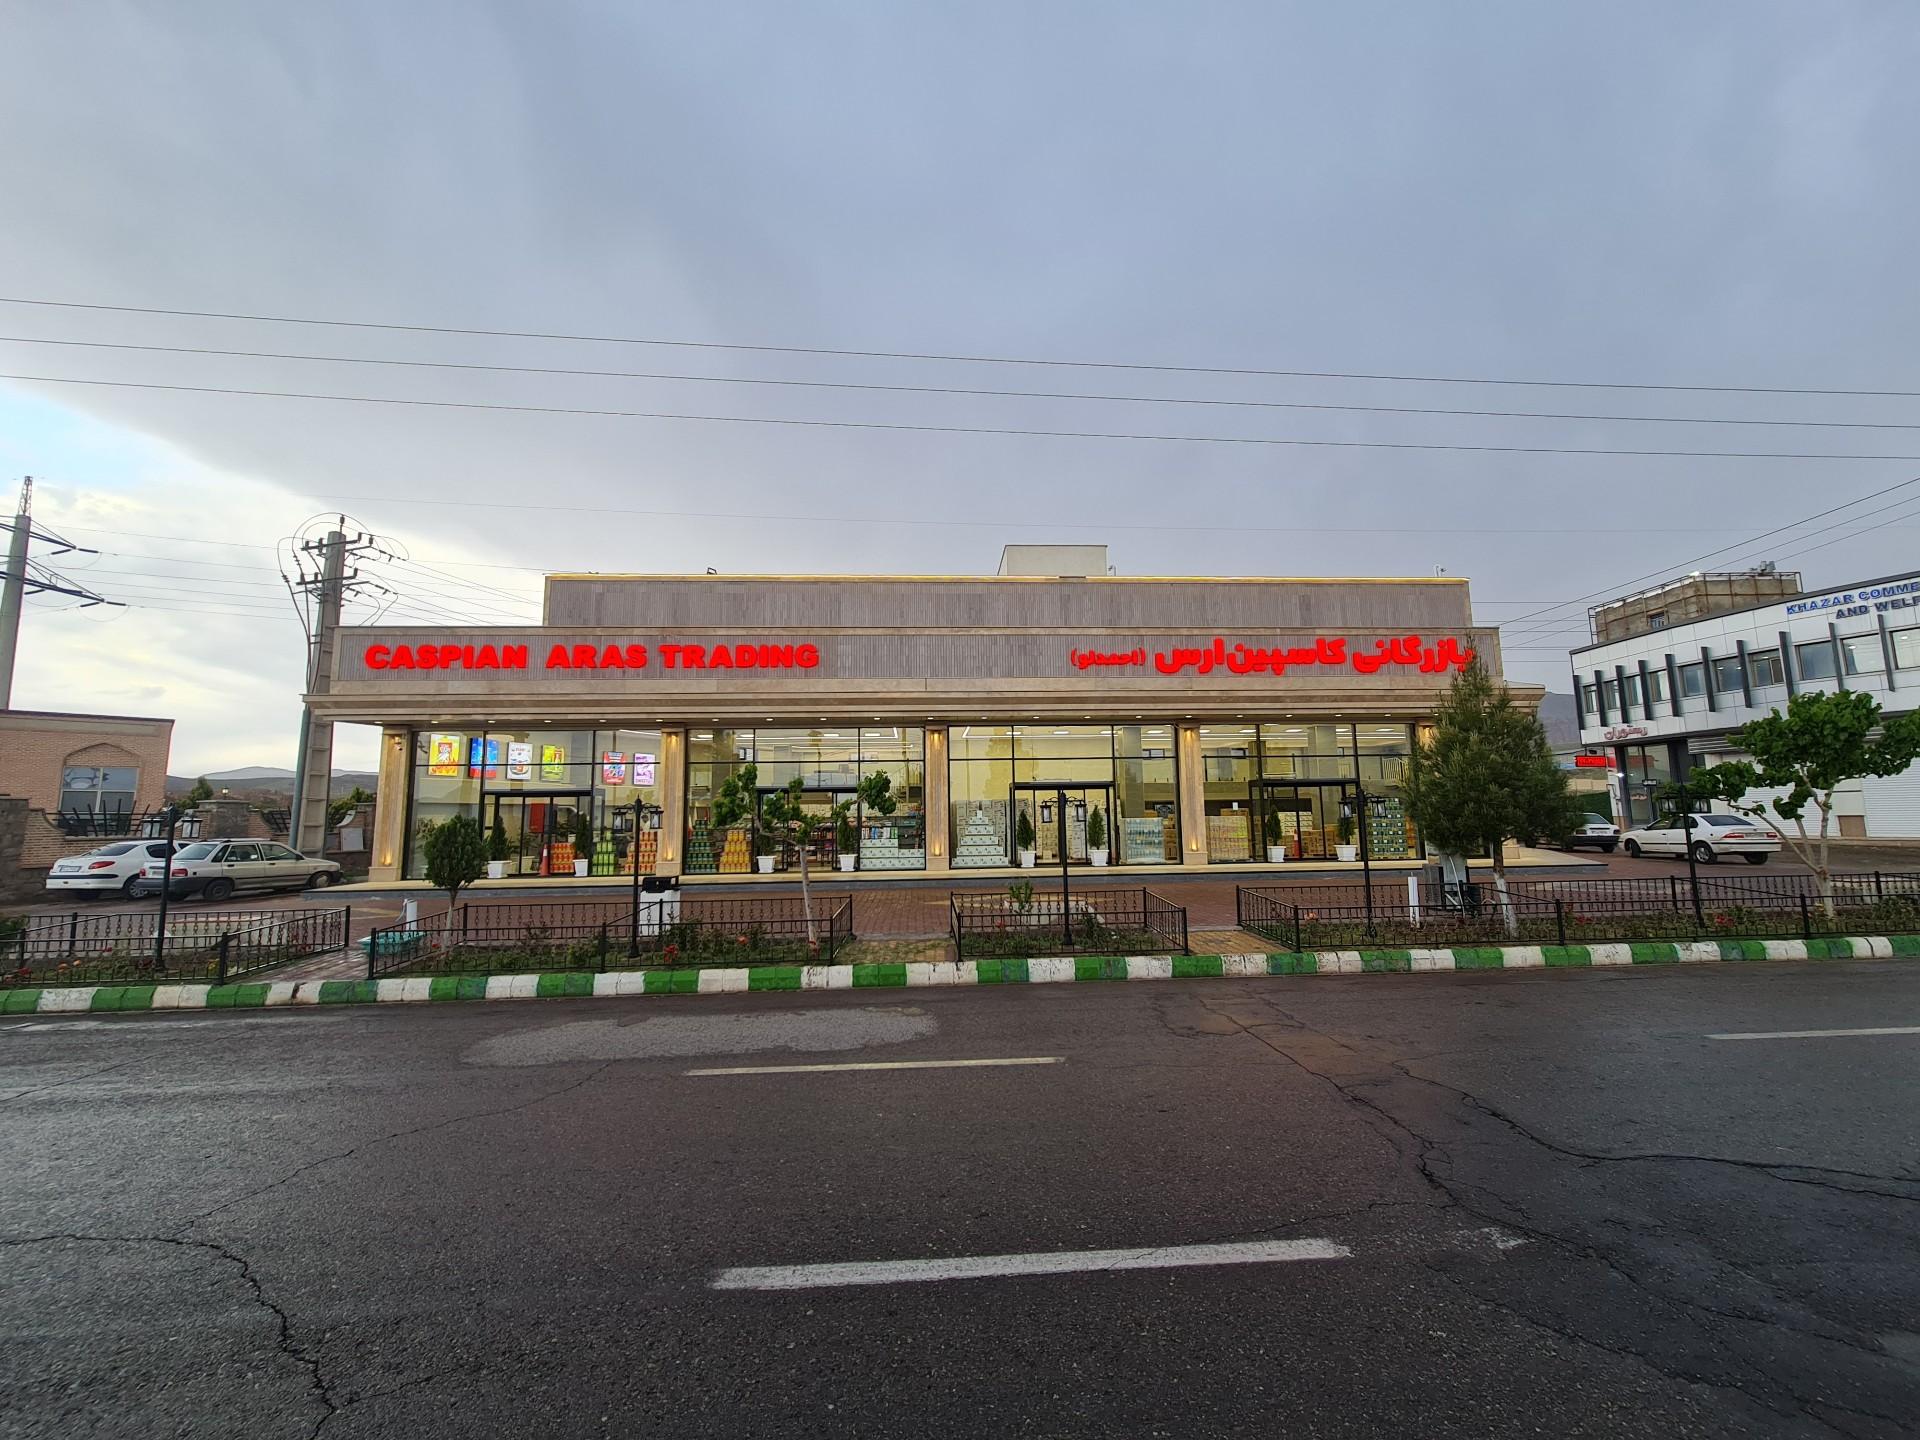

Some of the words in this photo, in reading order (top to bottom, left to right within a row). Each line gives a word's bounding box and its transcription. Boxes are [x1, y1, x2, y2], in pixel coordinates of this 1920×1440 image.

[1786, 594, 1855, 615] KHAZAR
[1836, 605, 1871, 620] AND
[364, 643, 529, 671] CASPIAN
[545, 643, 649, 671] ARAS
[657, 643, 820, 671] TRADING
[1154, 636, 1225, 675] ارس
[1226, 636, 1347, 677] کاسپین
